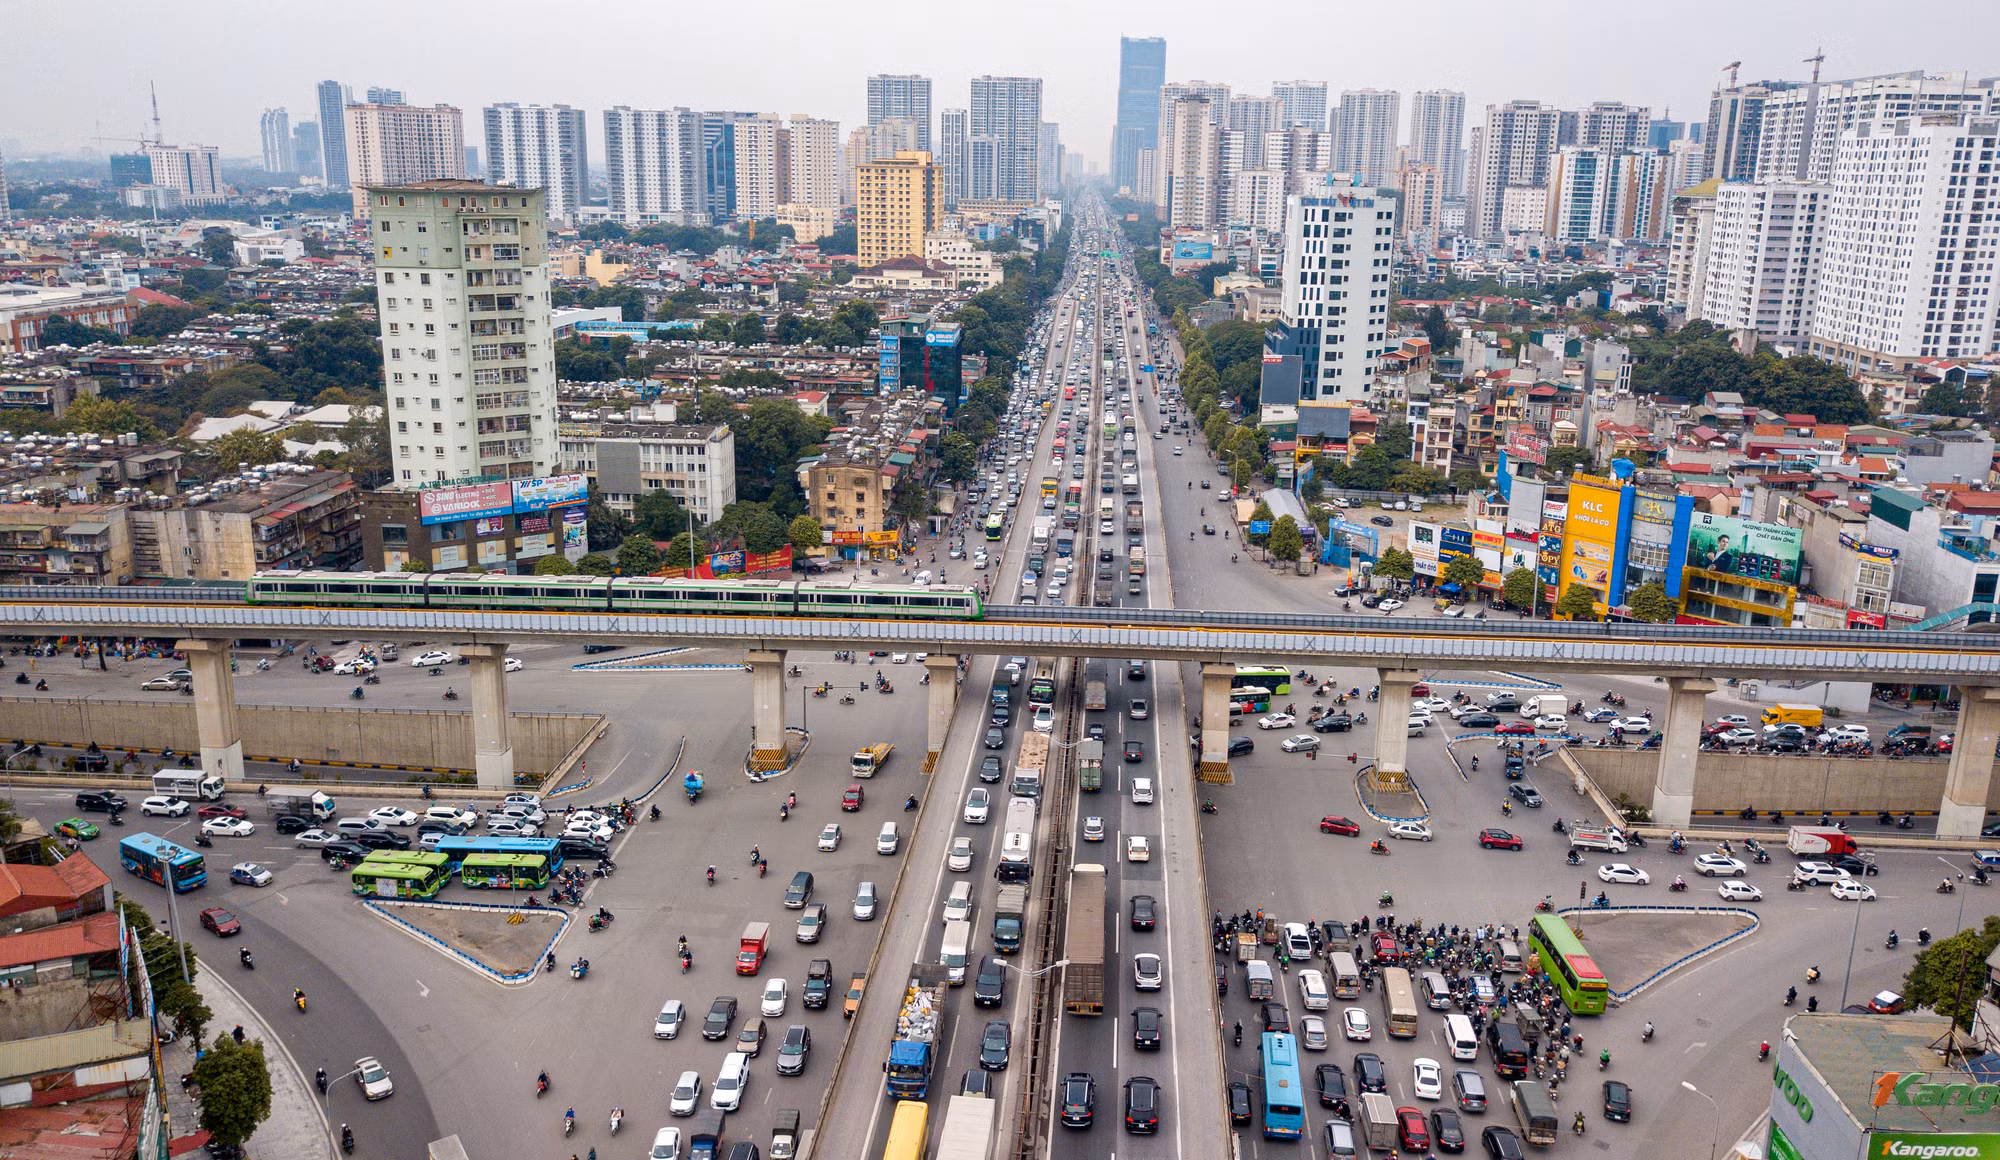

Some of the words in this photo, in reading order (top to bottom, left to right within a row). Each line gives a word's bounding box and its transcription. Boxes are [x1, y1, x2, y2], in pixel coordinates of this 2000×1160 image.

[436, 491, 453, 501] SINO
[455, 490, 480, 500] ELECTRIC
[442, 500, 480, 511] VANLOCK
[1582, 501, 1603, 512] KLC
[1693, 524, 1720, 533] ROMANO
